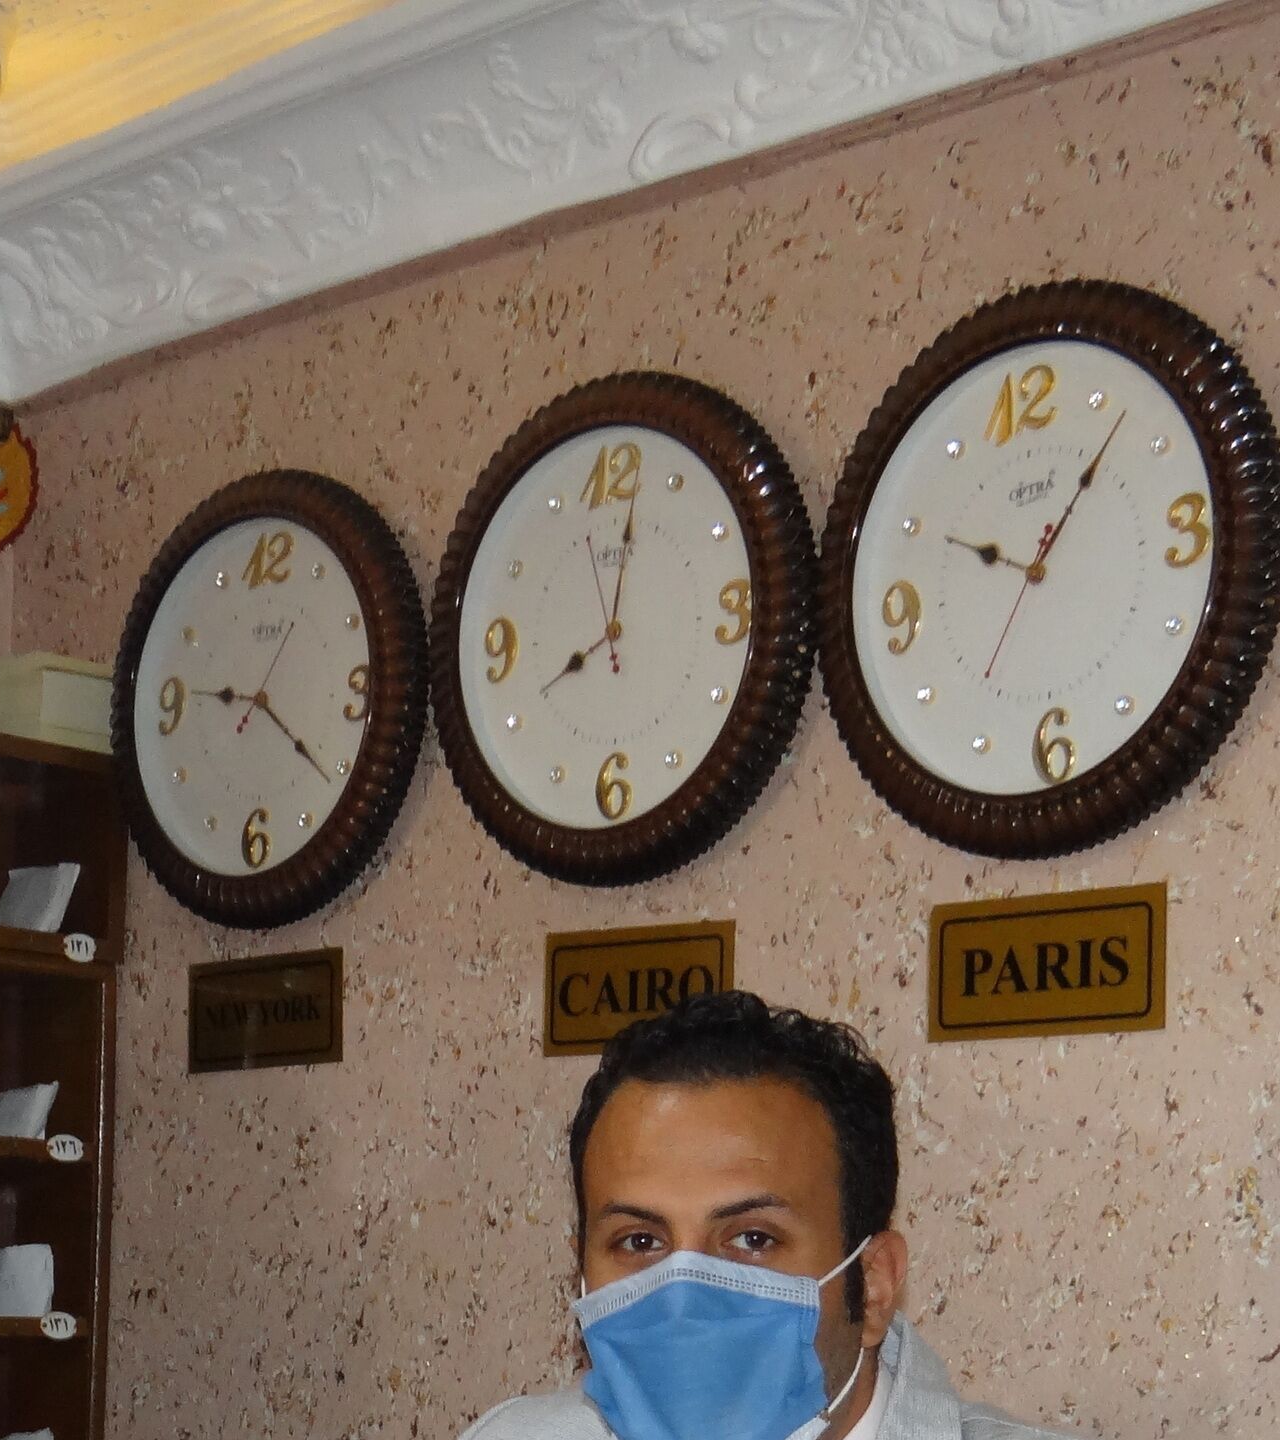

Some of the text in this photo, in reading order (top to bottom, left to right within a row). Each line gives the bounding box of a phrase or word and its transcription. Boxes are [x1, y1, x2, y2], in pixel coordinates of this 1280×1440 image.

[983, 364, 1058, 446] 12
[579, 443, 642, 509] 12
[241, 532, 294, 588] 12
[1164, 492, 1211, 568] 3
[715, 578, 751, 645] 3
[882, 580, 922, 655] 9
[484, 617, 519, 683] 9
[158, 676, 186, 735] 9
[343, 665, 370, 721] 3
[1032, 707, 1075, 784] 6
[595, 752, 632, 819] 6
[241, 808, 270, 868] 6
[559, 964, 714, 1017] CAIRO
[962, 935, 1130, 998] PARIS
[258, 994, 322, 1026] YORK
